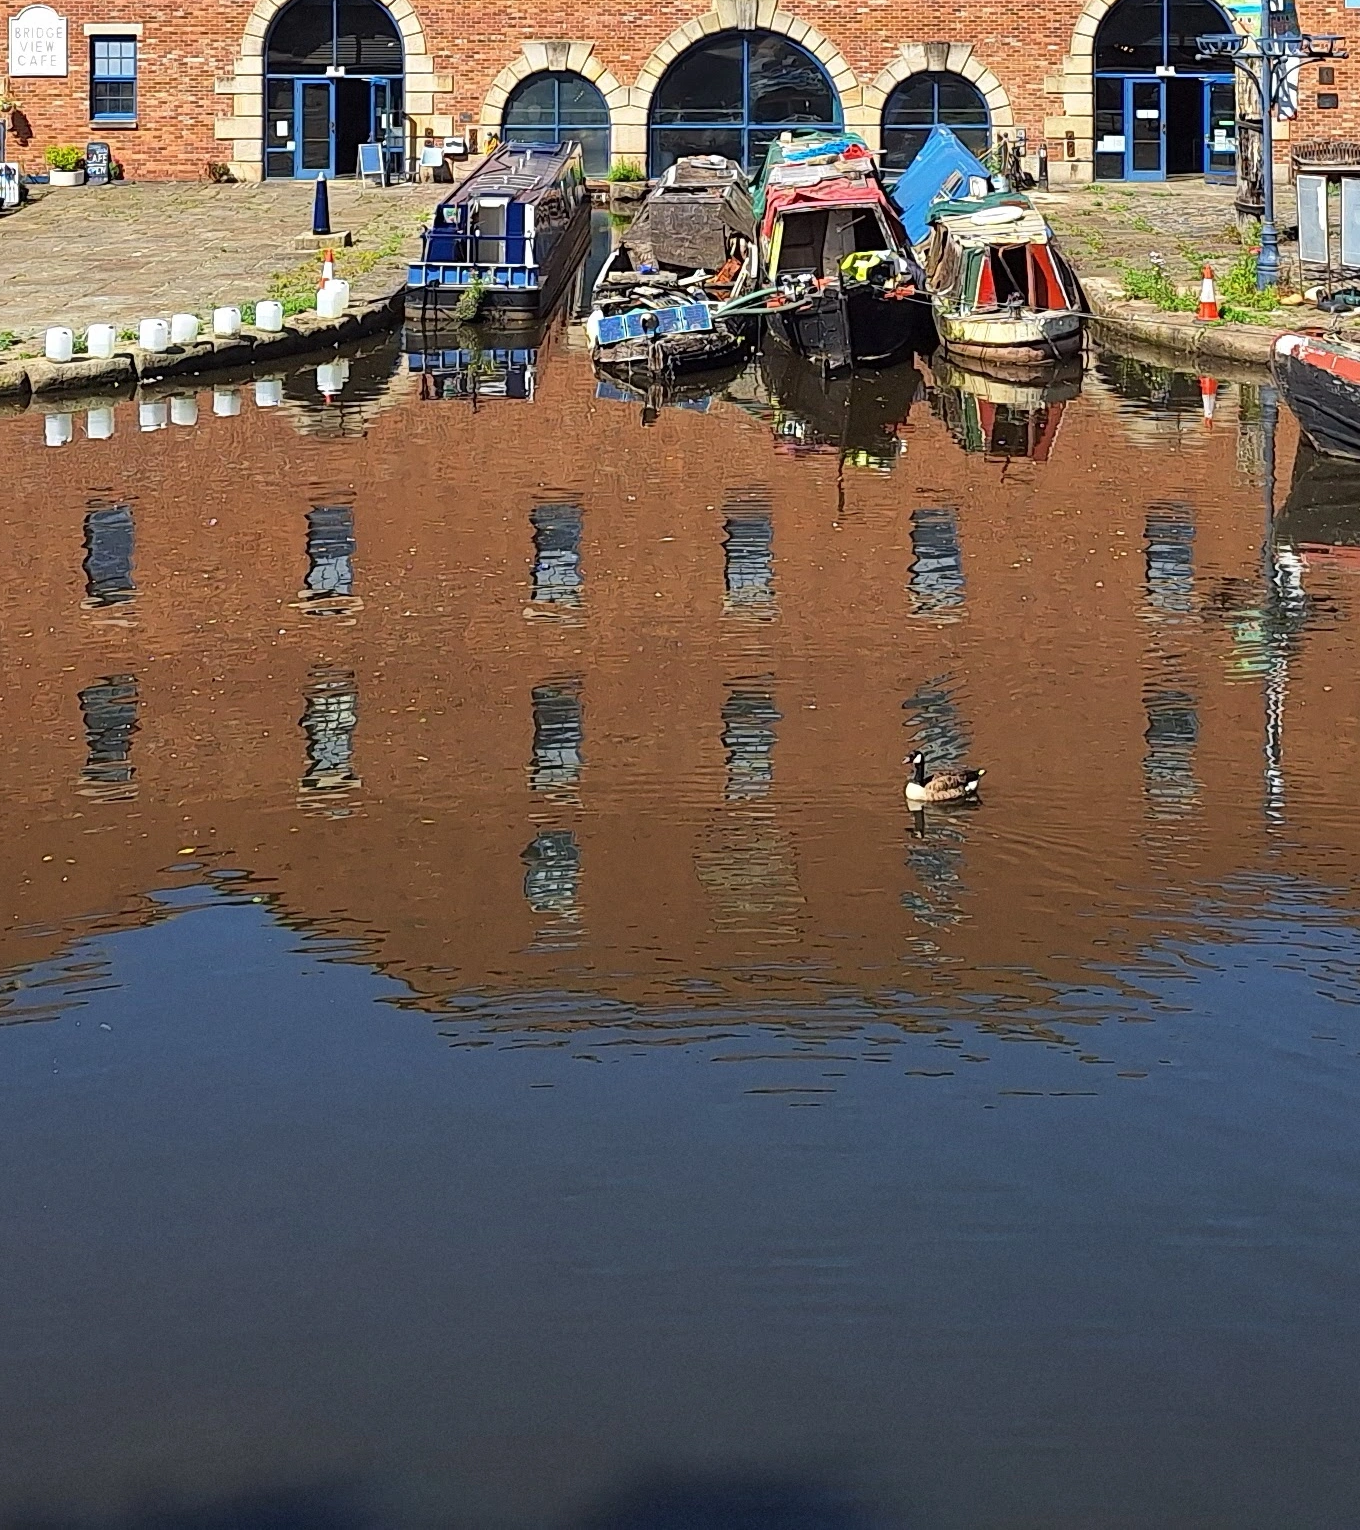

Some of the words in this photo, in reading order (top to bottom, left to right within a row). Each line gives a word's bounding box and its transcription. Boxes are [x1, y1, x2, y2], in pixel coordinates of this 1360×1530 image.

[14, 26, 63, 39] BRIDGE
[19, 41, 55, 53] VIEW
[17, 55, 57, 67] CAFE
